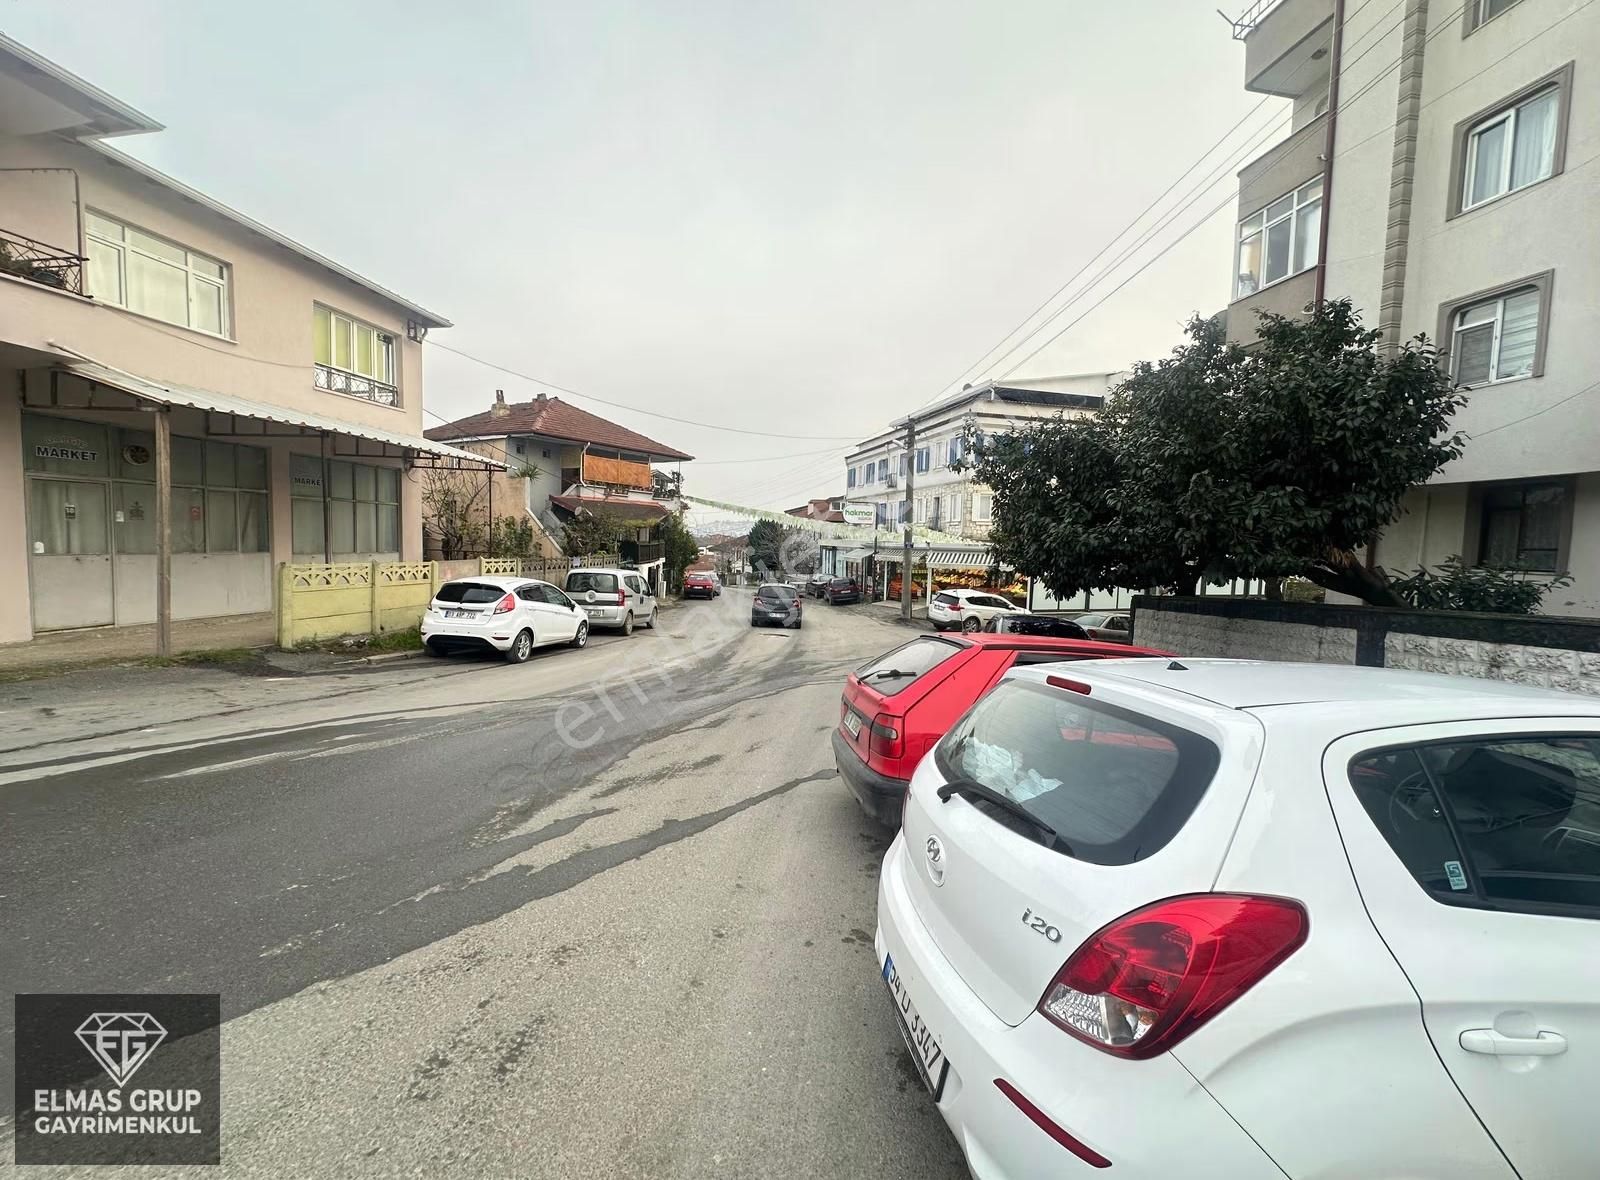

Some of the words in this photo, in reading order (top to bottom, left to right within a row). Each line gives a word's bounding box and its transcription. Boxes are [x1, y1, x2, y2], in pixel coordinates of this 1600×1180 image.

[36, 446, 97, 462] MARKET
[294, 477, 324, 487] MARKE
[1022, 907, 1062, 944] i20
[911, 1014, 942, 1070] 3347
